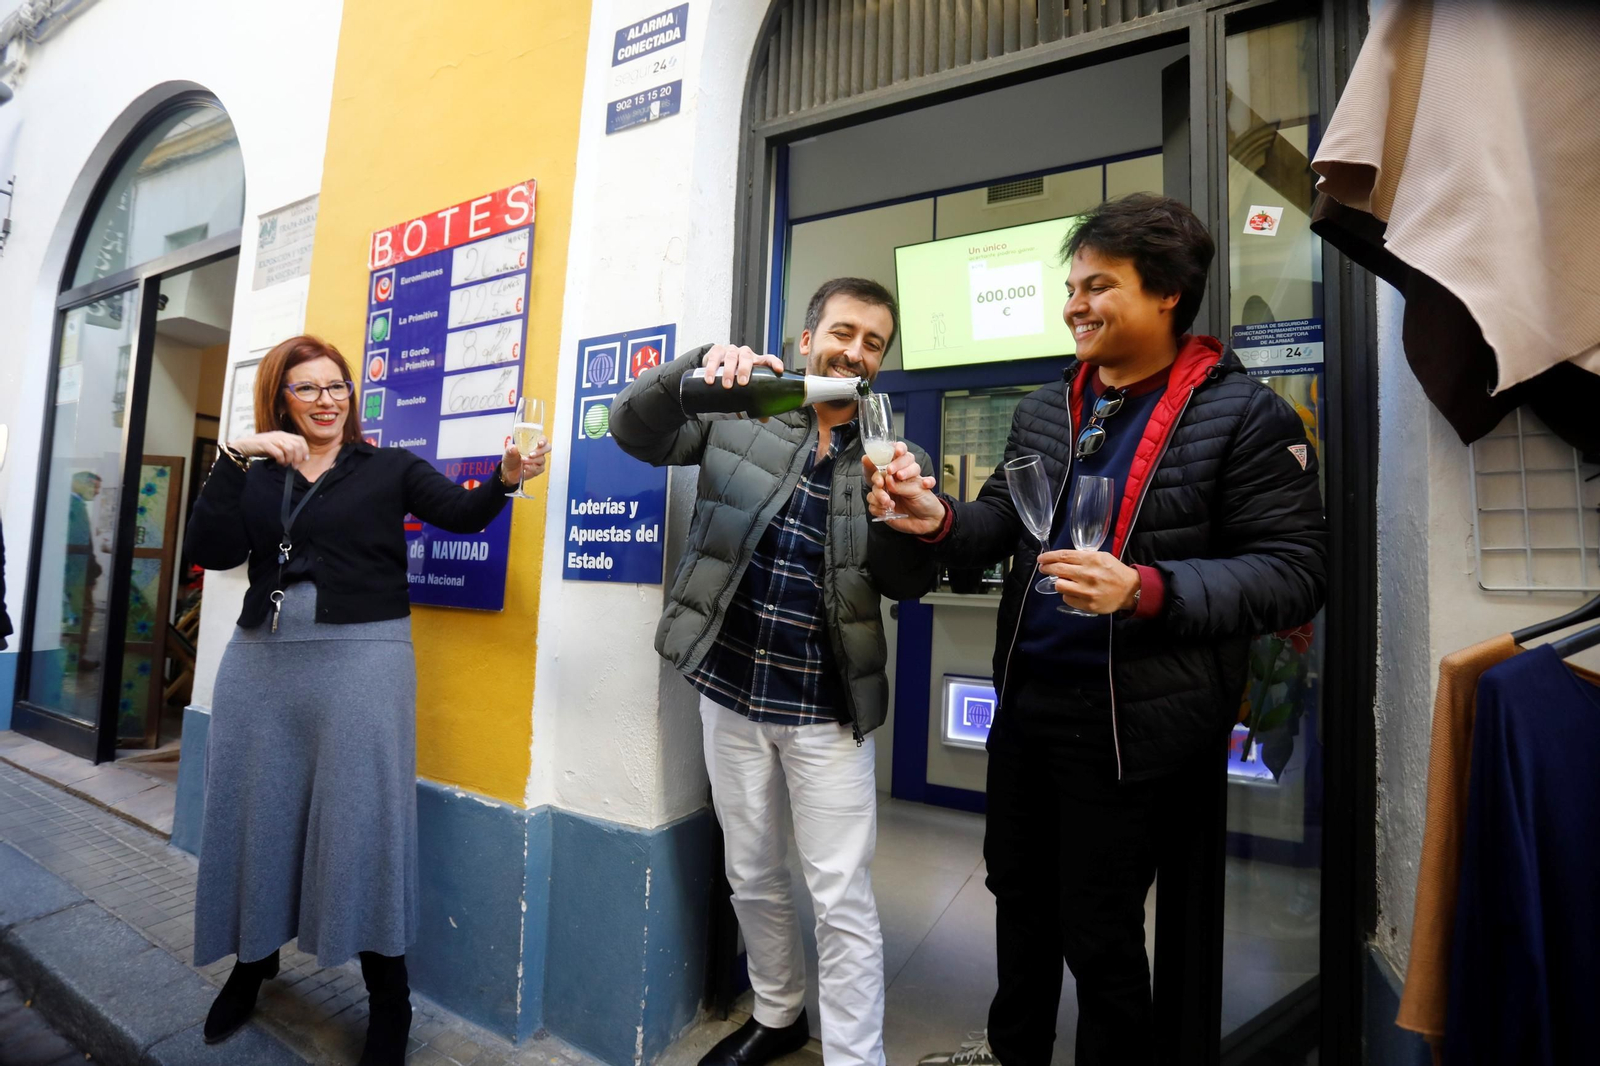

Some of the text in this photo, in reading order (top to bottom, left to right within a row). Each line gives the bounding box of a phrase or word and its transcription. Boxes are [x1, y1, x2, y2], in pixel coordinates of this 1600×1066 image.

[627, 12, 674, 41] ALARMA
[617, 26, 681, 61] CONECTADA
[616, 86, 672, 112] 902 15 15 20
[374, 185, 530, 268] BOTES
[968, 247, 981, 255] Un
[400, 268, 443, 285] Euromillones
[977, 285, 1036, 303] 600.000
[515, 297, 522, 312] €
[1003, 306, 1011, 316] €
[398, 310, 438, 325] La Primitiva
[1277, 320, 1309, 328] SEGURIDAD
[1234, 325, 1321, 337] CONECTADO PERMANENTEMENTE
[401, 347, 430, 359] El Gordo
[512, 343, 519, 358] €
[405, 359, 435, 371] Primitiva
[1271, 367, 1314, 375] www.segur24.es
[397, 396, 426, 407] Bonoloto
[508, 390, 515, 405] €
[390, 438, 427, 448] La Quiniela
[571, 497, 639, 519] Loterías y
[569, 524, 659, 546] Apuestas del
[410, 541, 489, 560] de NAVIDAD
[568, 552, 613, 570] Estado
[407, 573, 465, 586] tería Nacional
